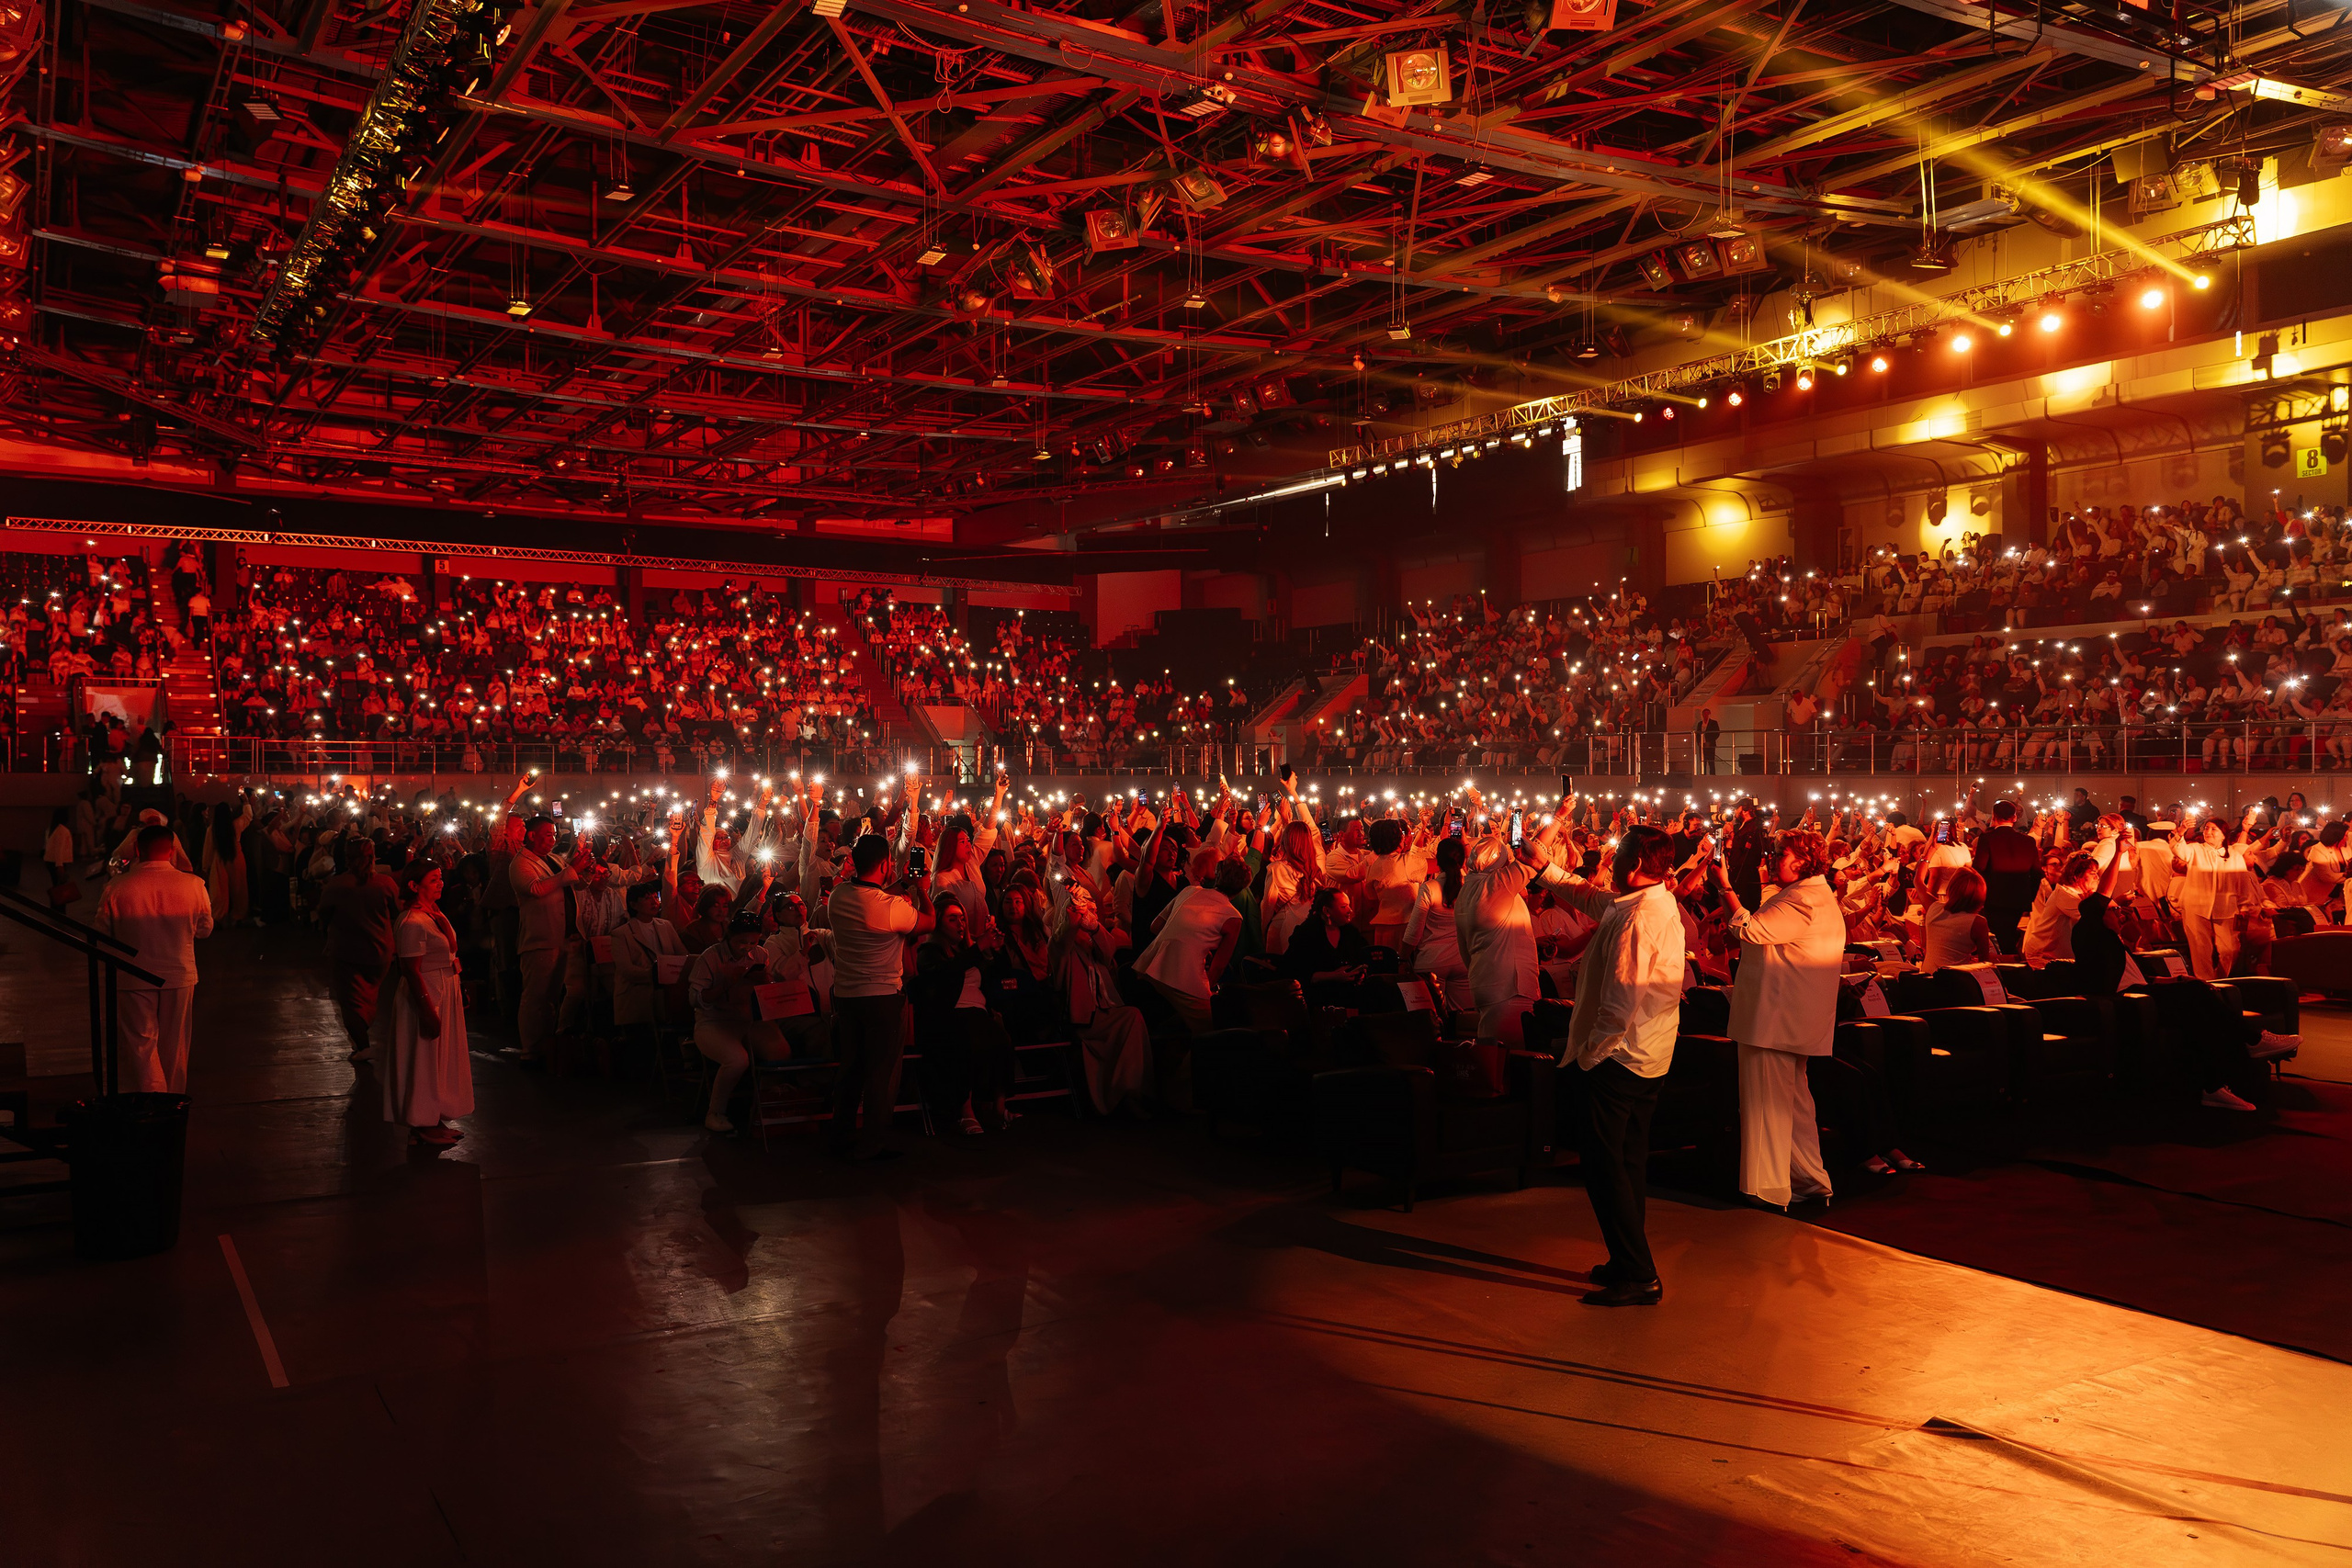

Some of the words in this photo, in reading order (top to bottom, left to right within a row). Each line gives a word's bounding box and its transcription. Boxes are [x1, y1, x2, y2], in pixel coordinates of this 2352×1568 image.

[2307, 448, 2319, 468] 8
[2301, 468, 2322, 477] SECTOR
[439, 560, 446, 570] 5
